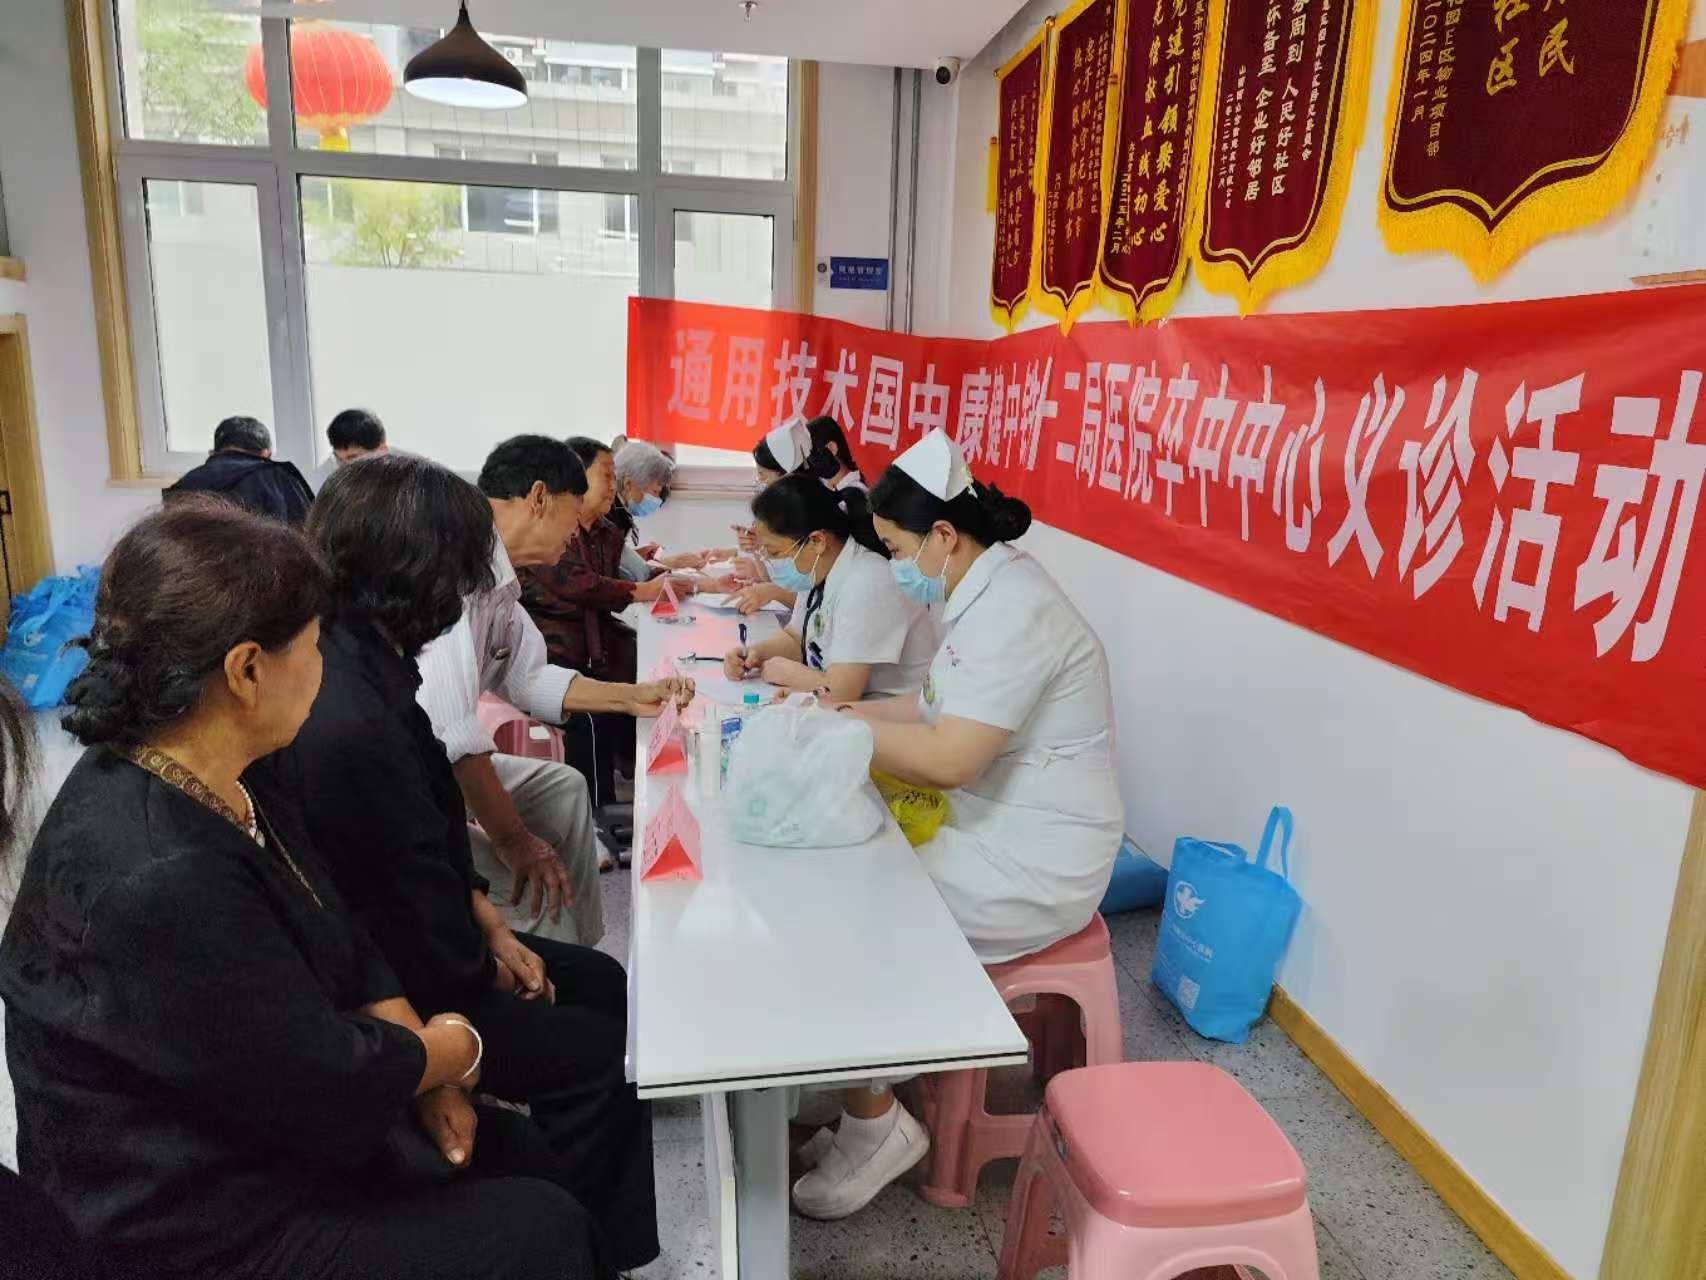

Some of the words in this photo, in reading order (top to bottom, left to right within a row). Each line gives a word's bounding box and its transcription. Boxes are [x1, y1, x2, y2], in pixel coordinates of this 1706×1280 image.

[1257, 0, 1282, 77] 怀备至
[1538, 0, 1576, 77] 民
[1271, 77, 1299, 196] 人民好社区
